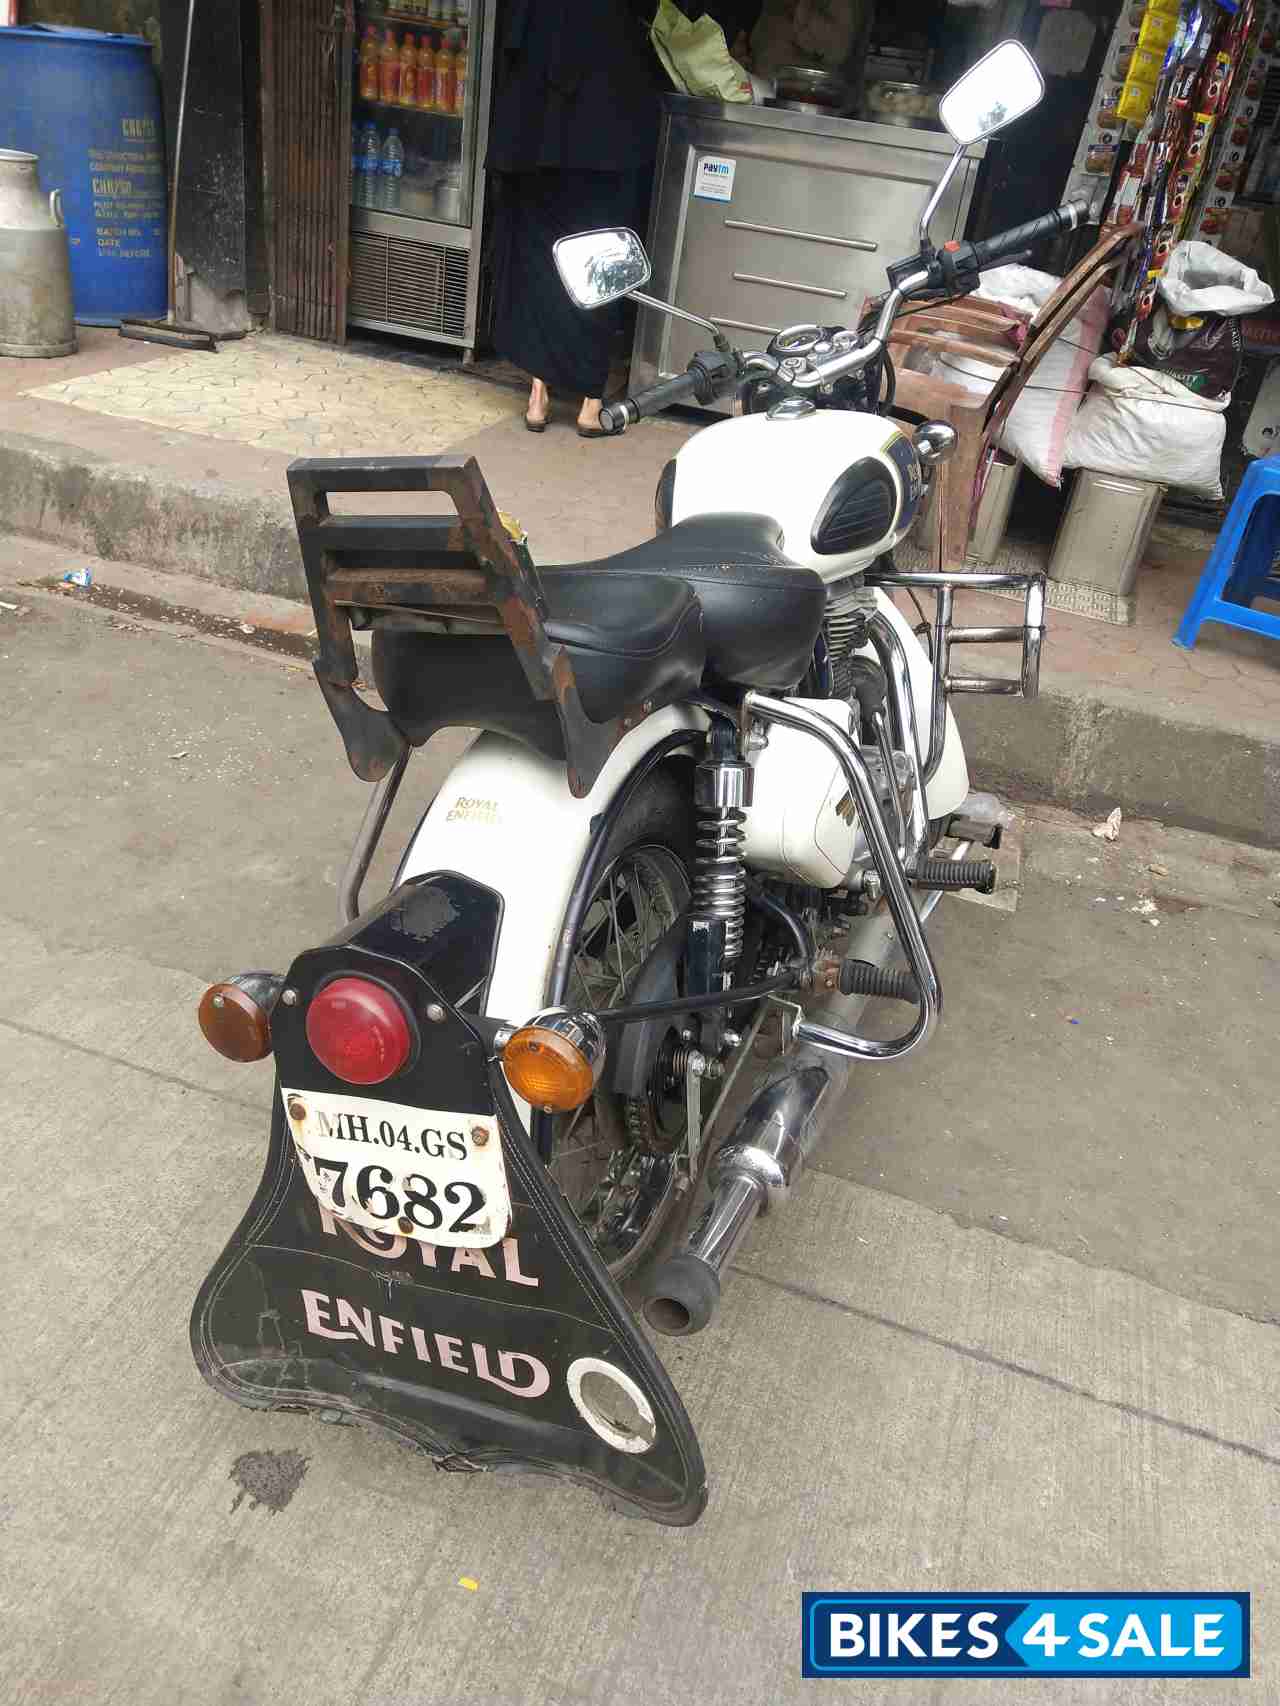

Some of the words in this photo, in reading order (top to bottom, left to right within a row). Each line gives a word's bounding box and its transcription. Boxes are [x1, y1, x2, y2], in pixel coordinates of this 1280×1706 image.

[316, 1110, 469, 1162] MH.04.GS
[313, 1156, 492, 1235] 7682
[301, 1288, 551, 1399] ENFIELD
